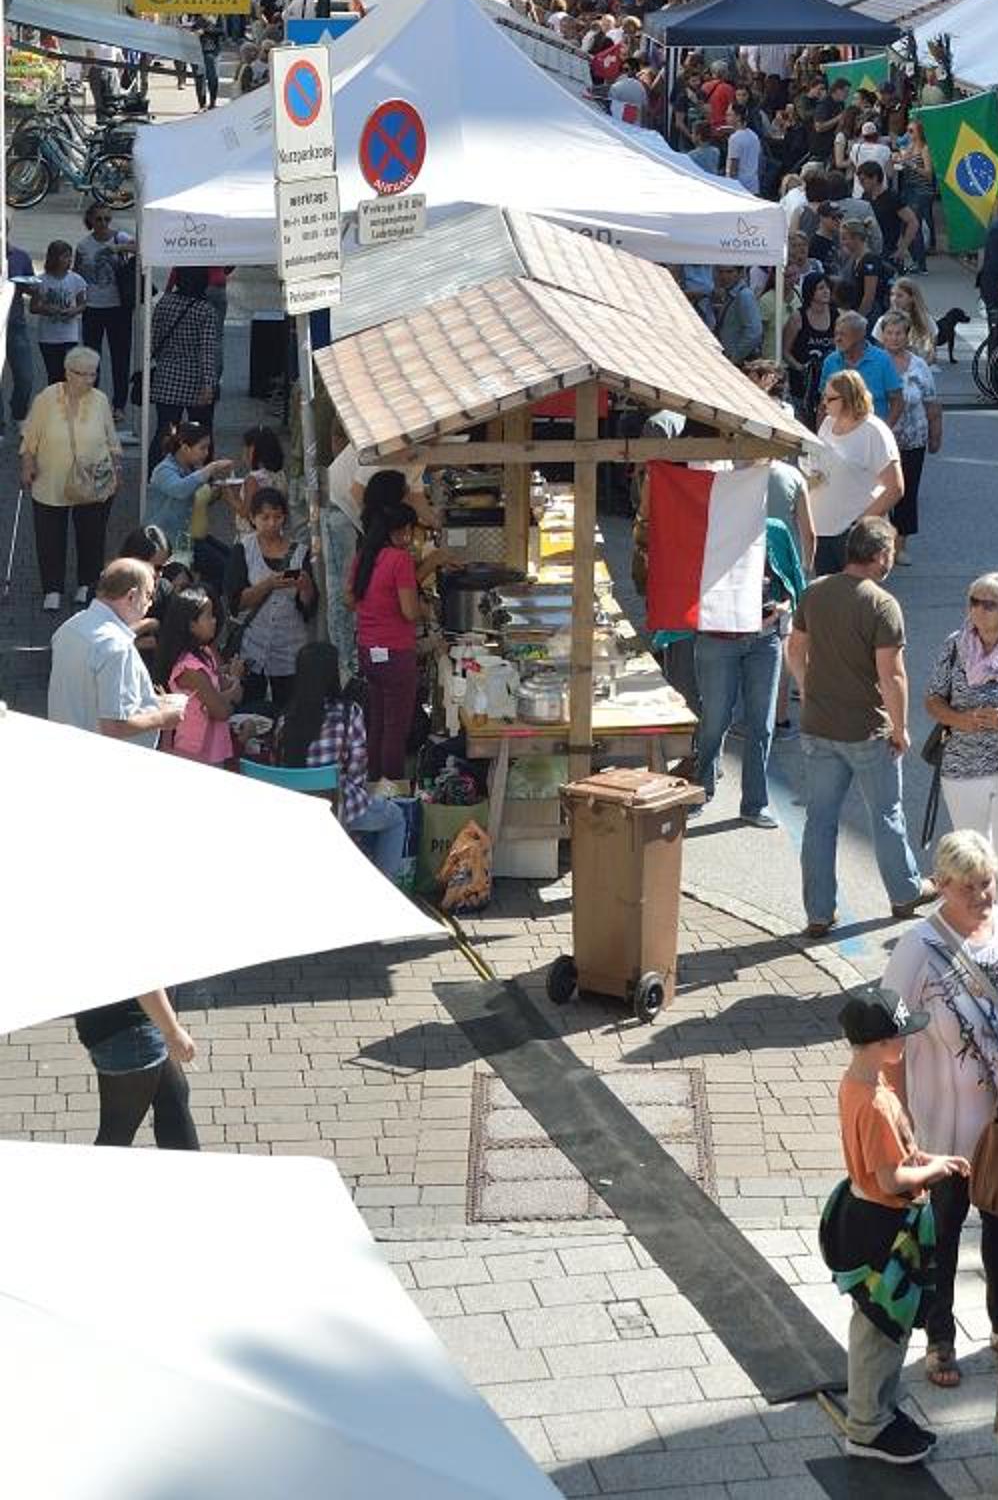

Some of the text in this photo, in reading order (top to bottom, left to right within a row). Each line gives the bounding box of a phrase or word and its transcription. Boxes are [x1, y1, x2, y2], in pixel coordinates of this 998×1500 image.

[373, 172, 415, 195] ANFANG
[289, 190, 329, 208] werktags
[163, 235, 217, 248] WÖRGL
